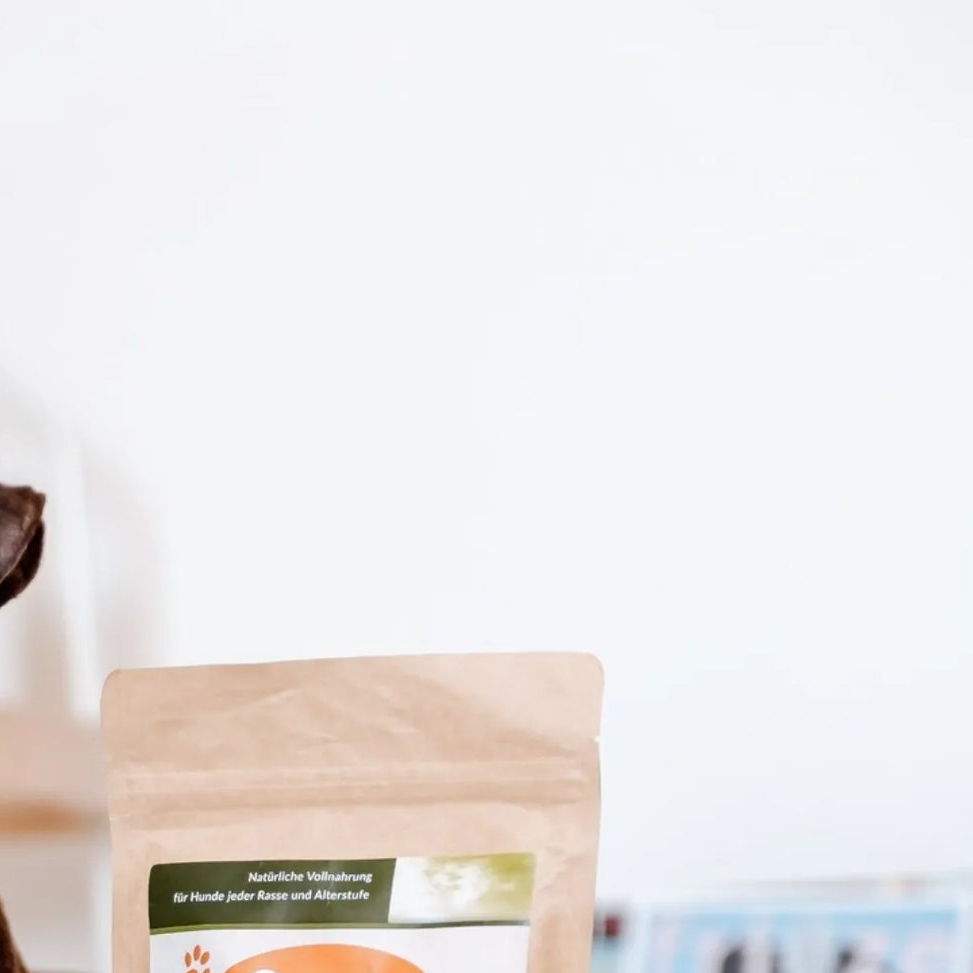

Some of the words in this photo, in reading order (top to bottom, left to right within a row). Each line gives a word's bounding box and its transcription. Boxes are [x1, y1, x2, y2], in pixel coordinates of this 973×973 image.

[248, 872, 304, 883] Natürliche
[307, 871, 373, 884] Vollnahrung
[173, 891, 188, 904] für
[190, 891, 225, 903] Hunde
[226, 890, 255, 904] jeder
[257, 889, 288, 901] Rasse
[291, 889, 312, 901] und
[314, 888, 370, 900] Alterstufe
